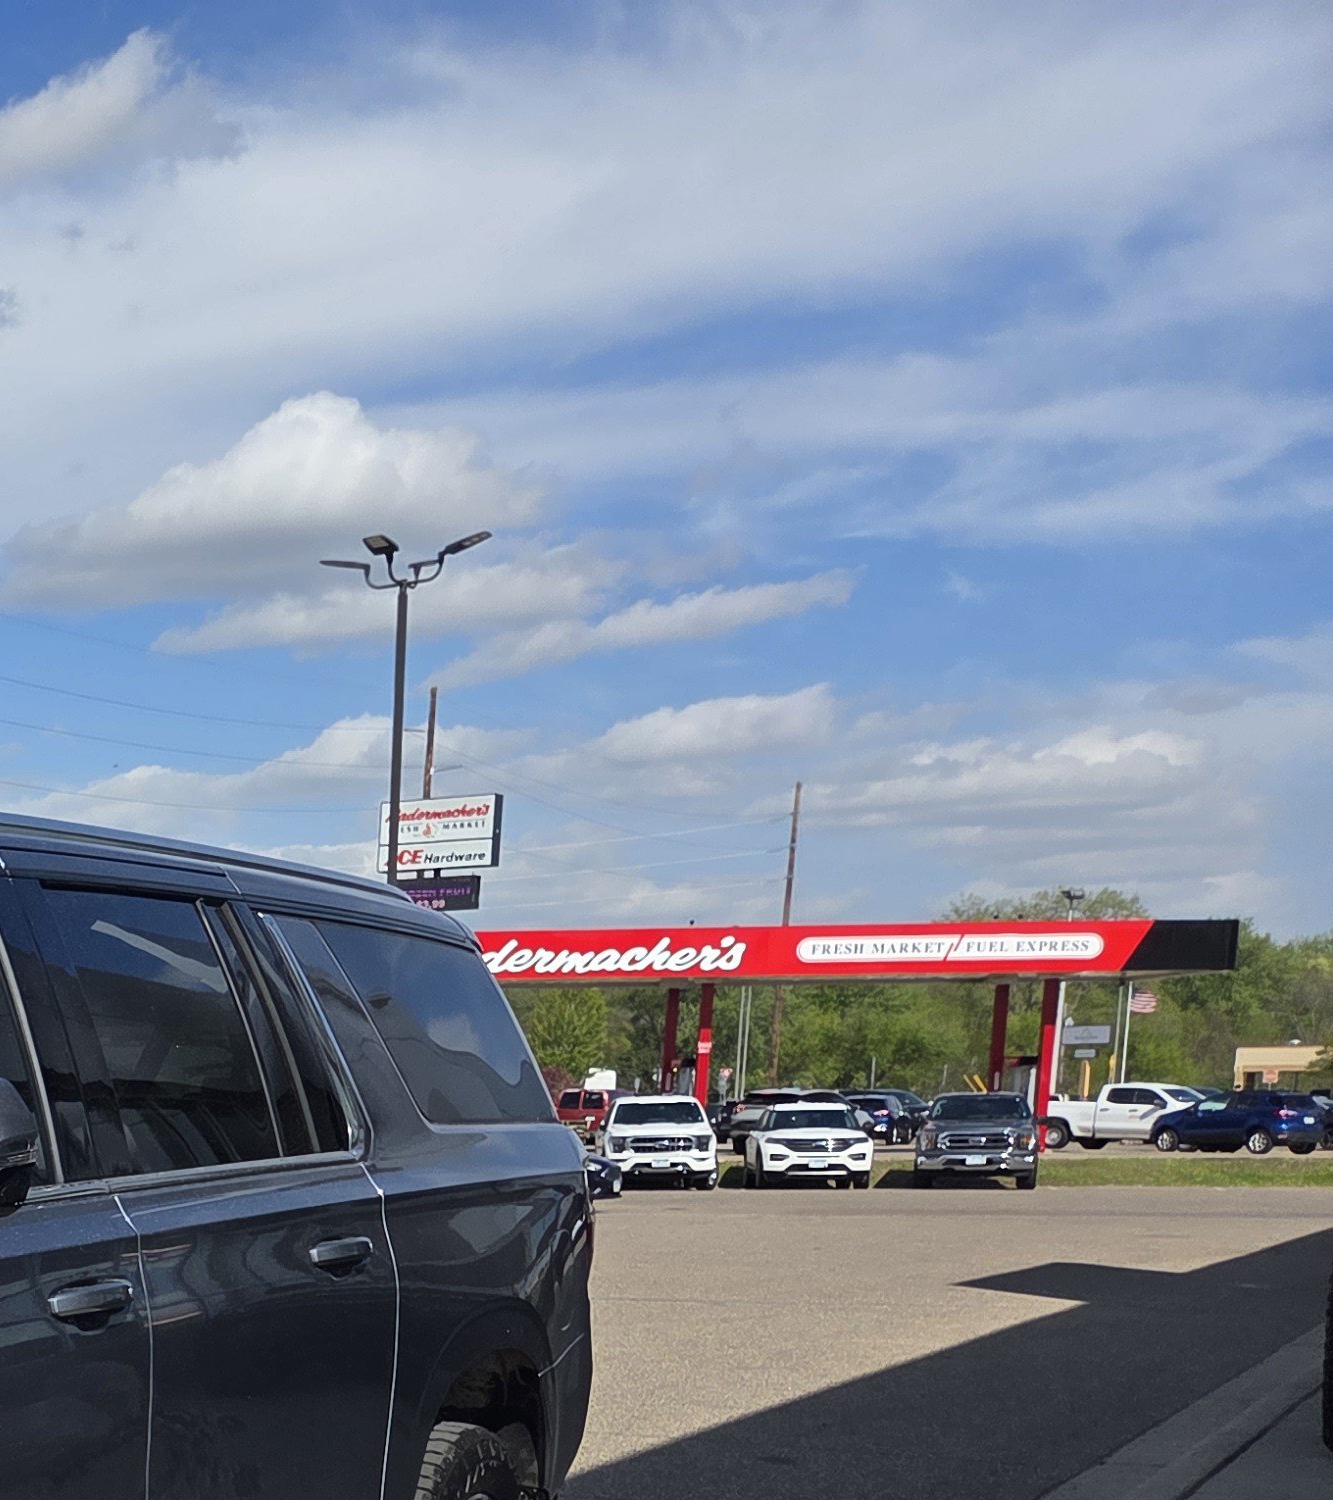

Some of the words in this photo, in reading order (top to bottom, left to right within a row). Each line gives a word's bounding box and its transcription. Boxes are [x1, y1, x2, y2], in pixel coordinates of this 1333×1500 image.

[384, 850, 424, 866] CE
[423, 851, 486, 864] Hardware
[482, 935, 746, 974] dermacher's
[811, 943, 865, 956] FRESH
[871, 941, 946, 955] MARKET
[966, 940, 1009, 953] FUEL
[1015, 939, 1091, 953] EXPRESS
